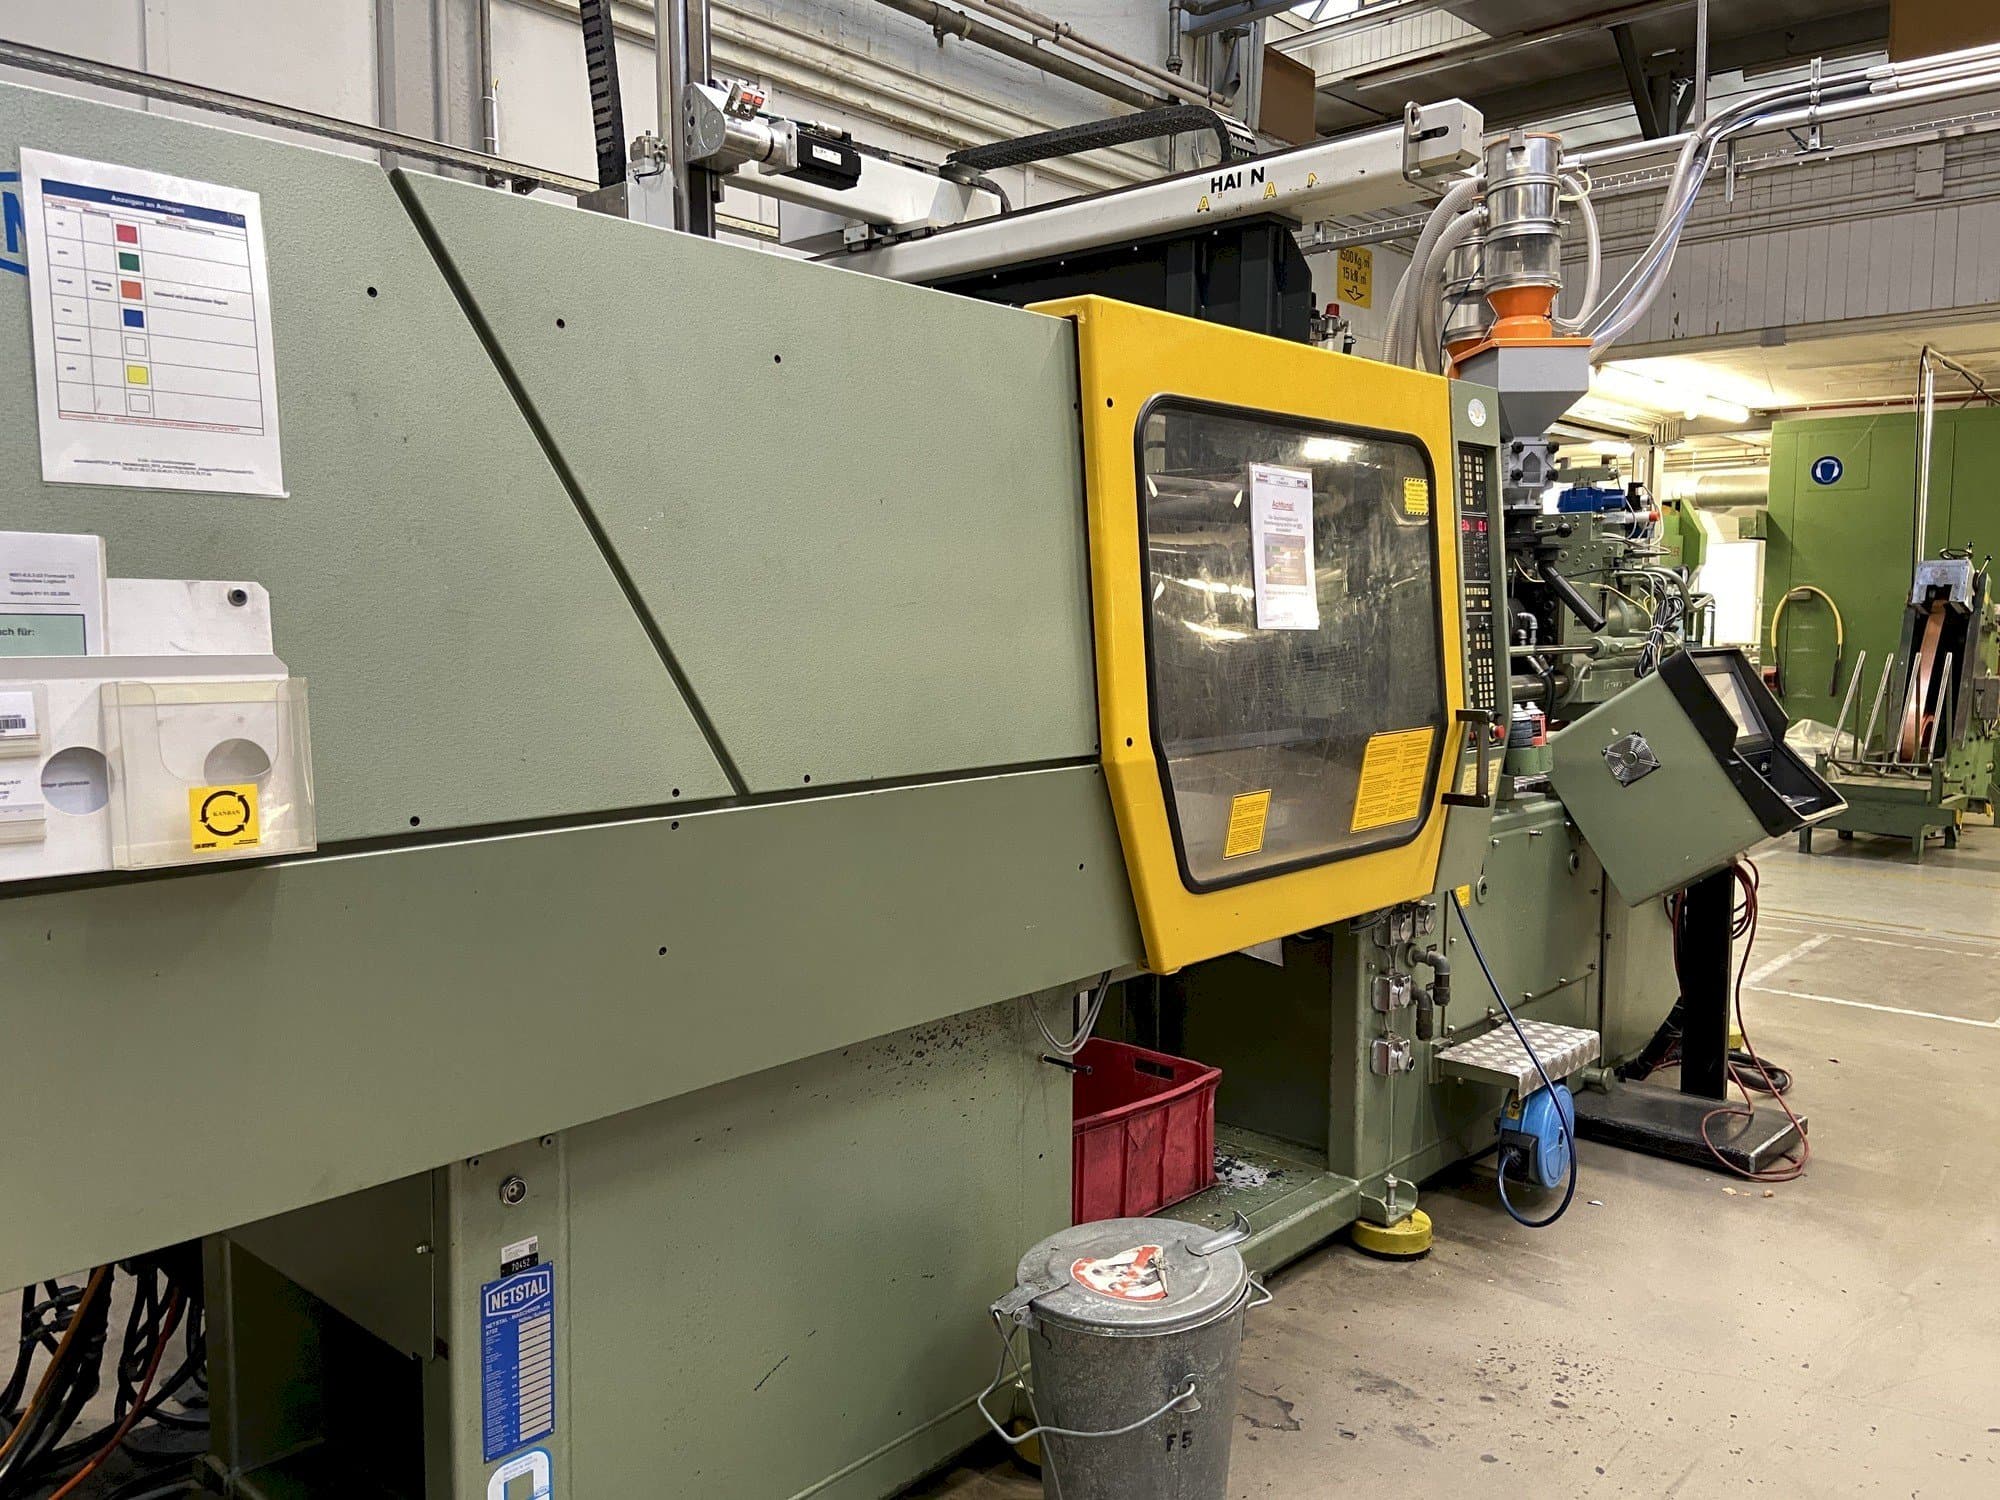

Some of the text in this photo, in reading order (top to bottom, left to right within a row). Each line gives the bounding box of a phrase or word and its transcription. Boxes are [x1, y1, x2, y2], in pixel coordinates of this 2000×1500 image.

[111, 194, 185, 215] Anzeigen an Anlagen
[17, 627, 35, 636] für:
[491, 1276, 547, 1312] NETSTAL
